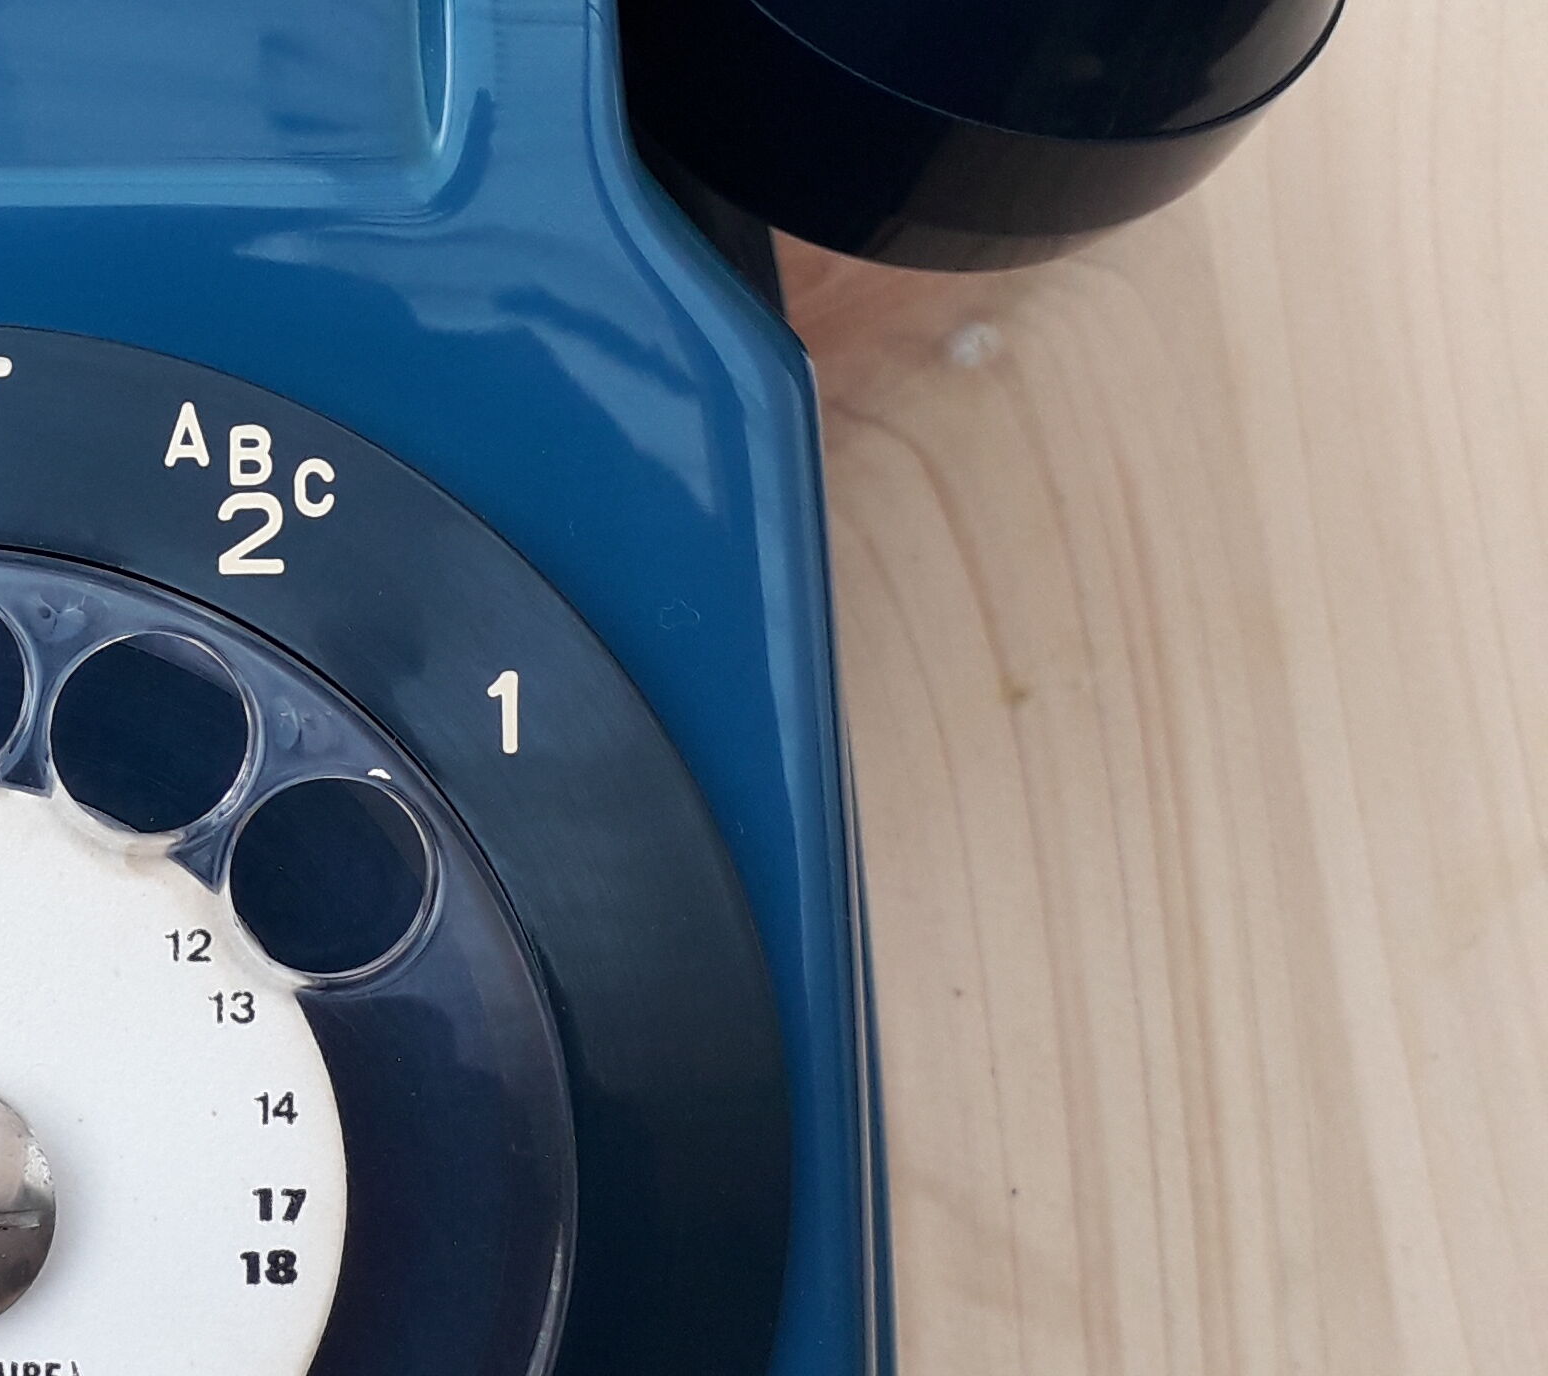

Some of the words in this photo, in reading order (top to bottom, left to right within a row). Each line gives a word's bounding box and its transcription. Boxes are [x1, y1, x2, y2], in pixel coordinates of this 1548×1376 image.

[163, 400, 337, 519] ABC
[216, 490, 286, 576] 2
[485, 669, 520, 755] 1
[164, 928, 214, 963] 12
[211, 991, 256, 1024] 13
[255, 1090, 299, 1126] 14
[251, 1187, 309, 1224] 17
[239, 1248, 299, 1286] 18
